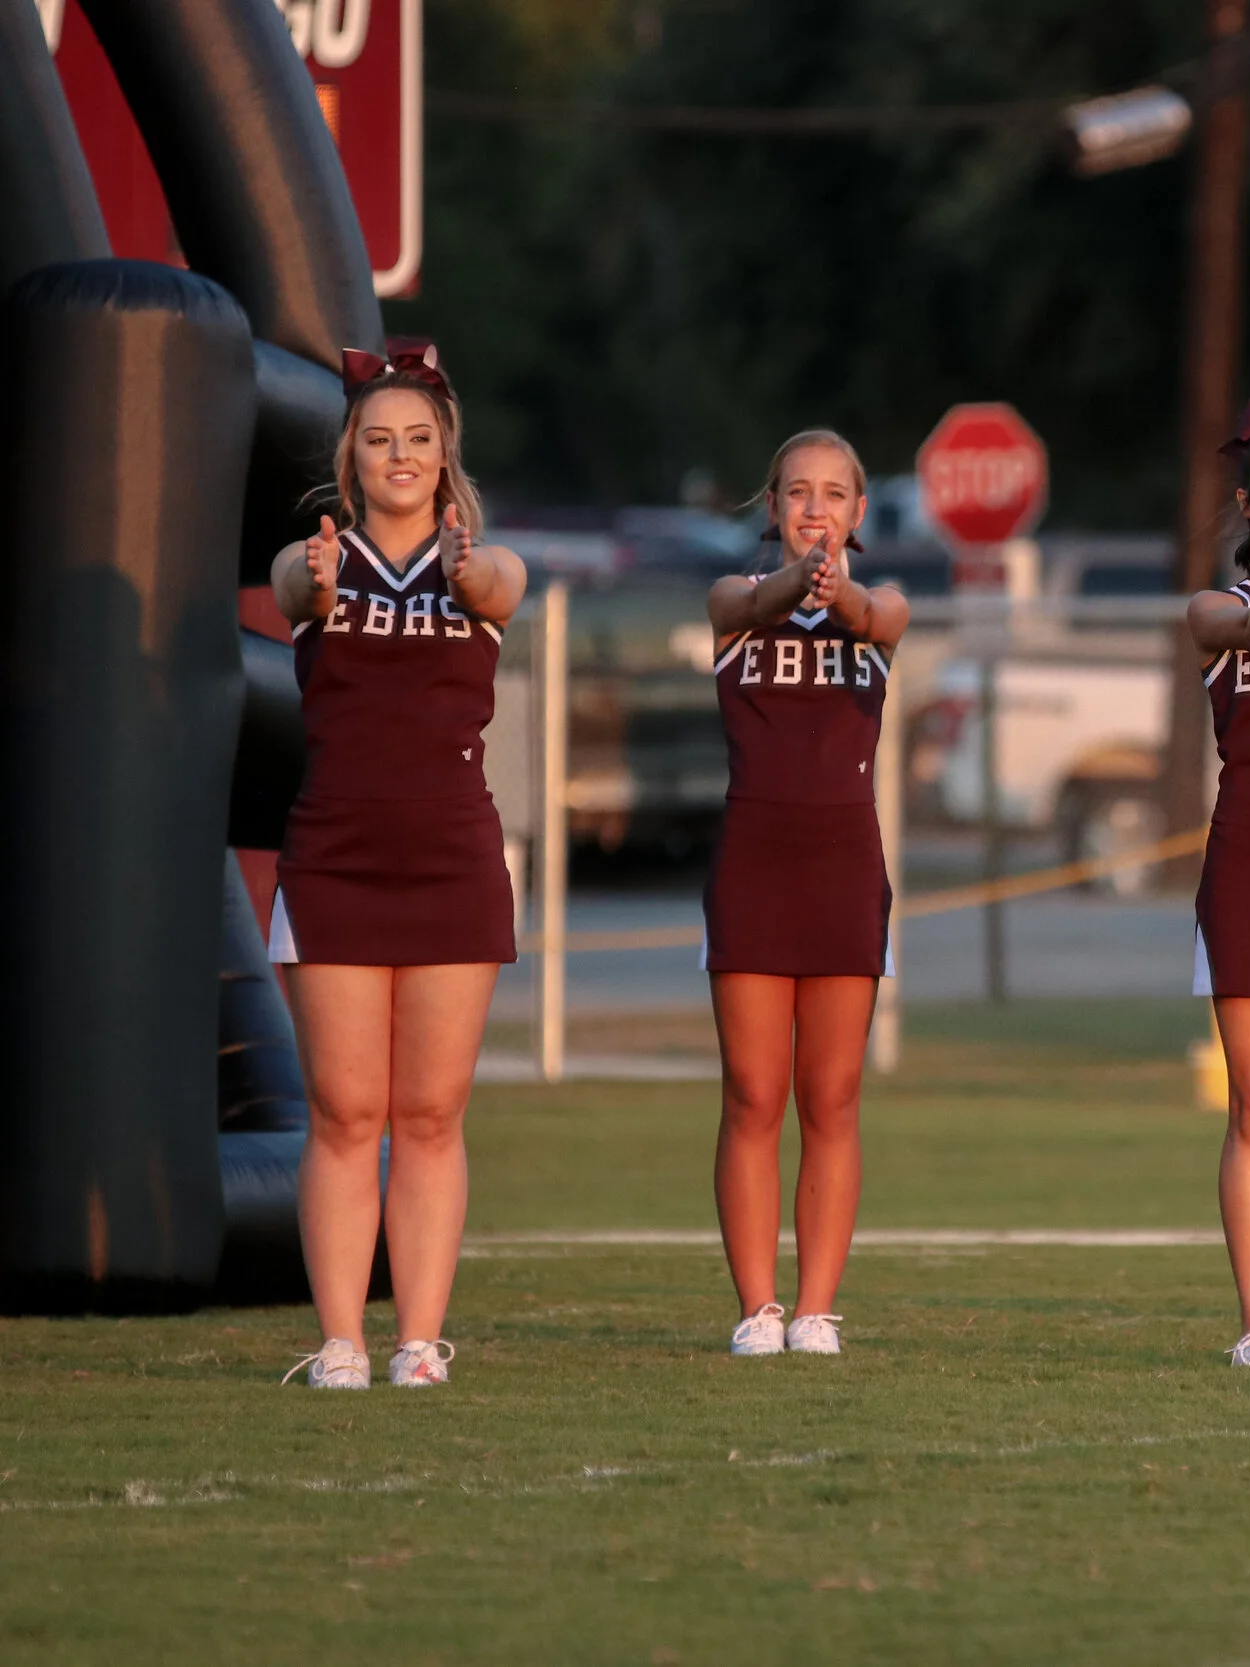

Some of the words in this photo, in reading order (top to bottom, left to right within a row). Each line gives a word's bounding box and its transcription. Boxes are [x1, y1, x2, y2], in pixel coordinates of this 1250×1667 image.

[928, 449, 1038, 507] STOP
[322, 588, 472, 639] EBHS
[739, 639, 872, 687] EBHS
